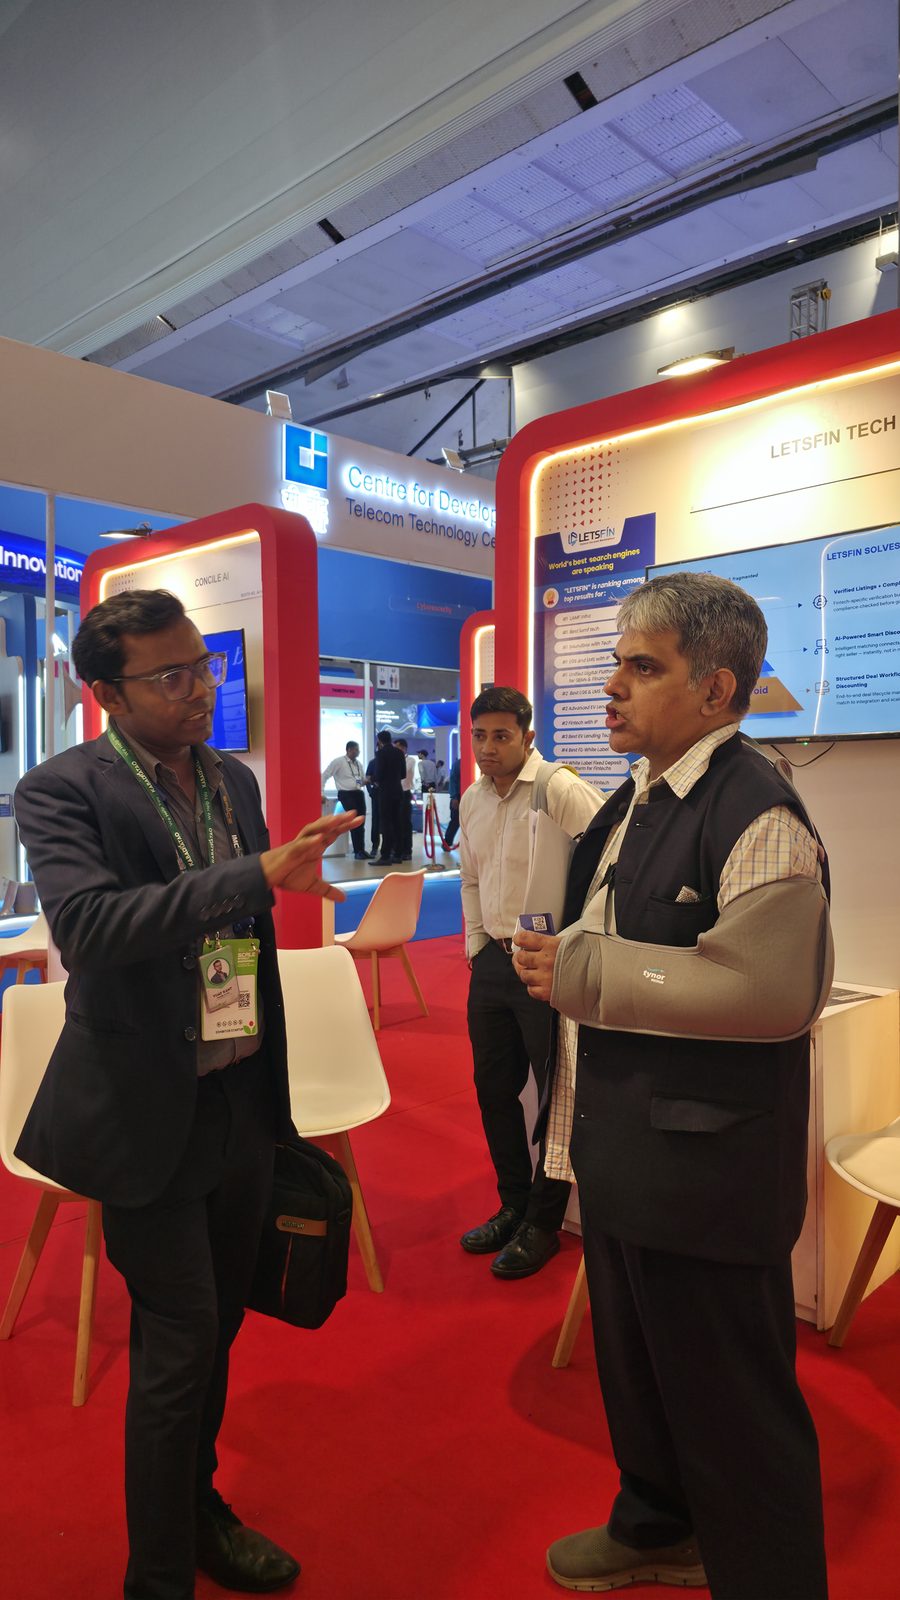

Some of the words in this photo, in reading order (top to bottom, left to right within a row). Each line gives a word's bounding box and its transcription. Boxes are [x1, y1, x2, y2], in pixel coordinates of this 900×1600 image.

[771, 429, 840, 459] LETSFIN
[846, 415, 896, 440] TECH
[348, 465, 407, 501] Centre
[413, 482, 434, 507] for
[346, 497, 404, 528] Telecom
[409, 513, 479, 548] Technology
[573, 558, 587, 566] best
[589, 553, 612, 563] search
[613, 548, 640, 560] engines
[827, 548, 862, 561] LETSFIN
[864, 542, 900, 555] SOLVES
[0, 545, 83, 582] Innovtion
[584, 563, 614, 574] speaking
[195, 573, 222, 588] CONCILE
[222, 571, 230, 582] AI
[598, 579, 621, 589] ranking
[622, 576, 646, 585] among
[855, 584, 877, 592] Listings
[574, 592, 594, 600] results
[834, 633, 866, 641] AI-Powered
[752, 686, 769, 695] oid
[231, 834, 239, 849] IMC
[643, 970, 666, 981] tynor
